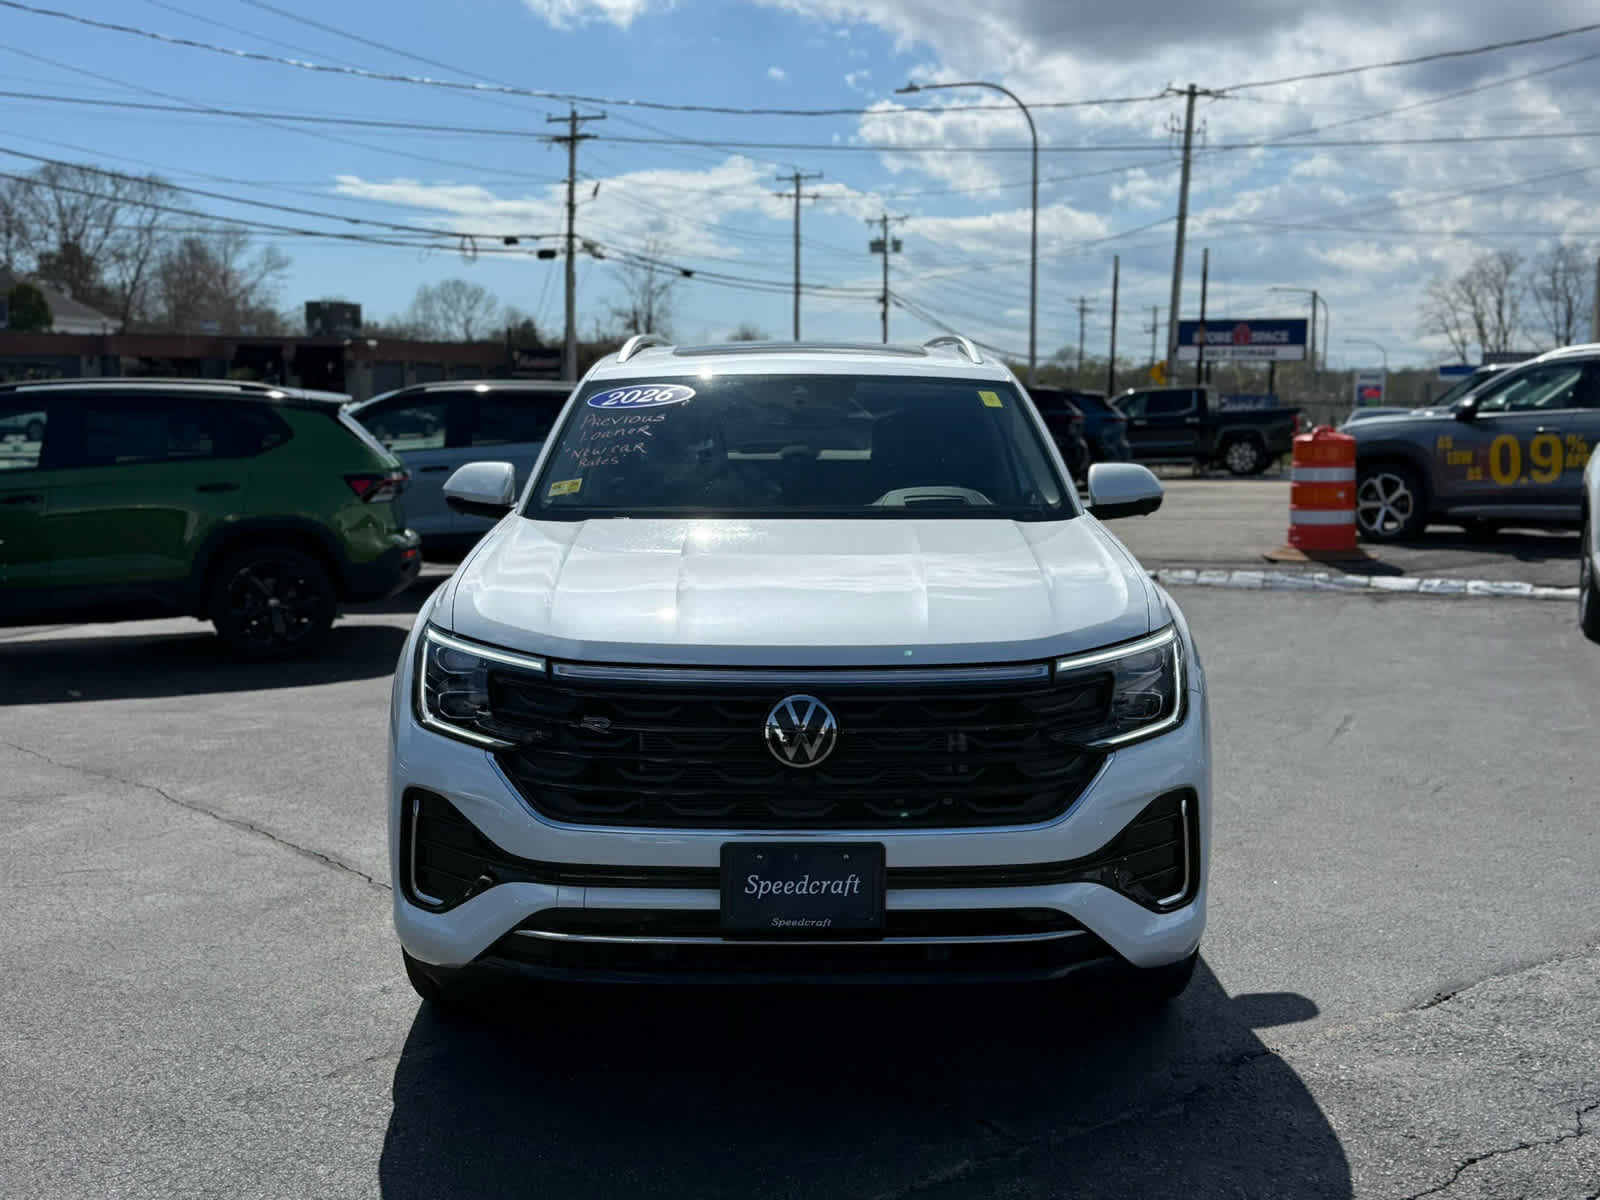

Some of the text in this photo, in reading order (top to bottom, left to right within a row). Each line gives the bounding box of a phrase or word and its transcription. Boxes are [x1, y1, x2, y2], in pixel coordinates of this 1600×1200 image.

[601, 387, 673, 408] 2026
[1489, 433, 1564, 486] 0.9
[744, 873, 862, 900] Speedcraft
[770, 916, 832, 928] Speedcraft
